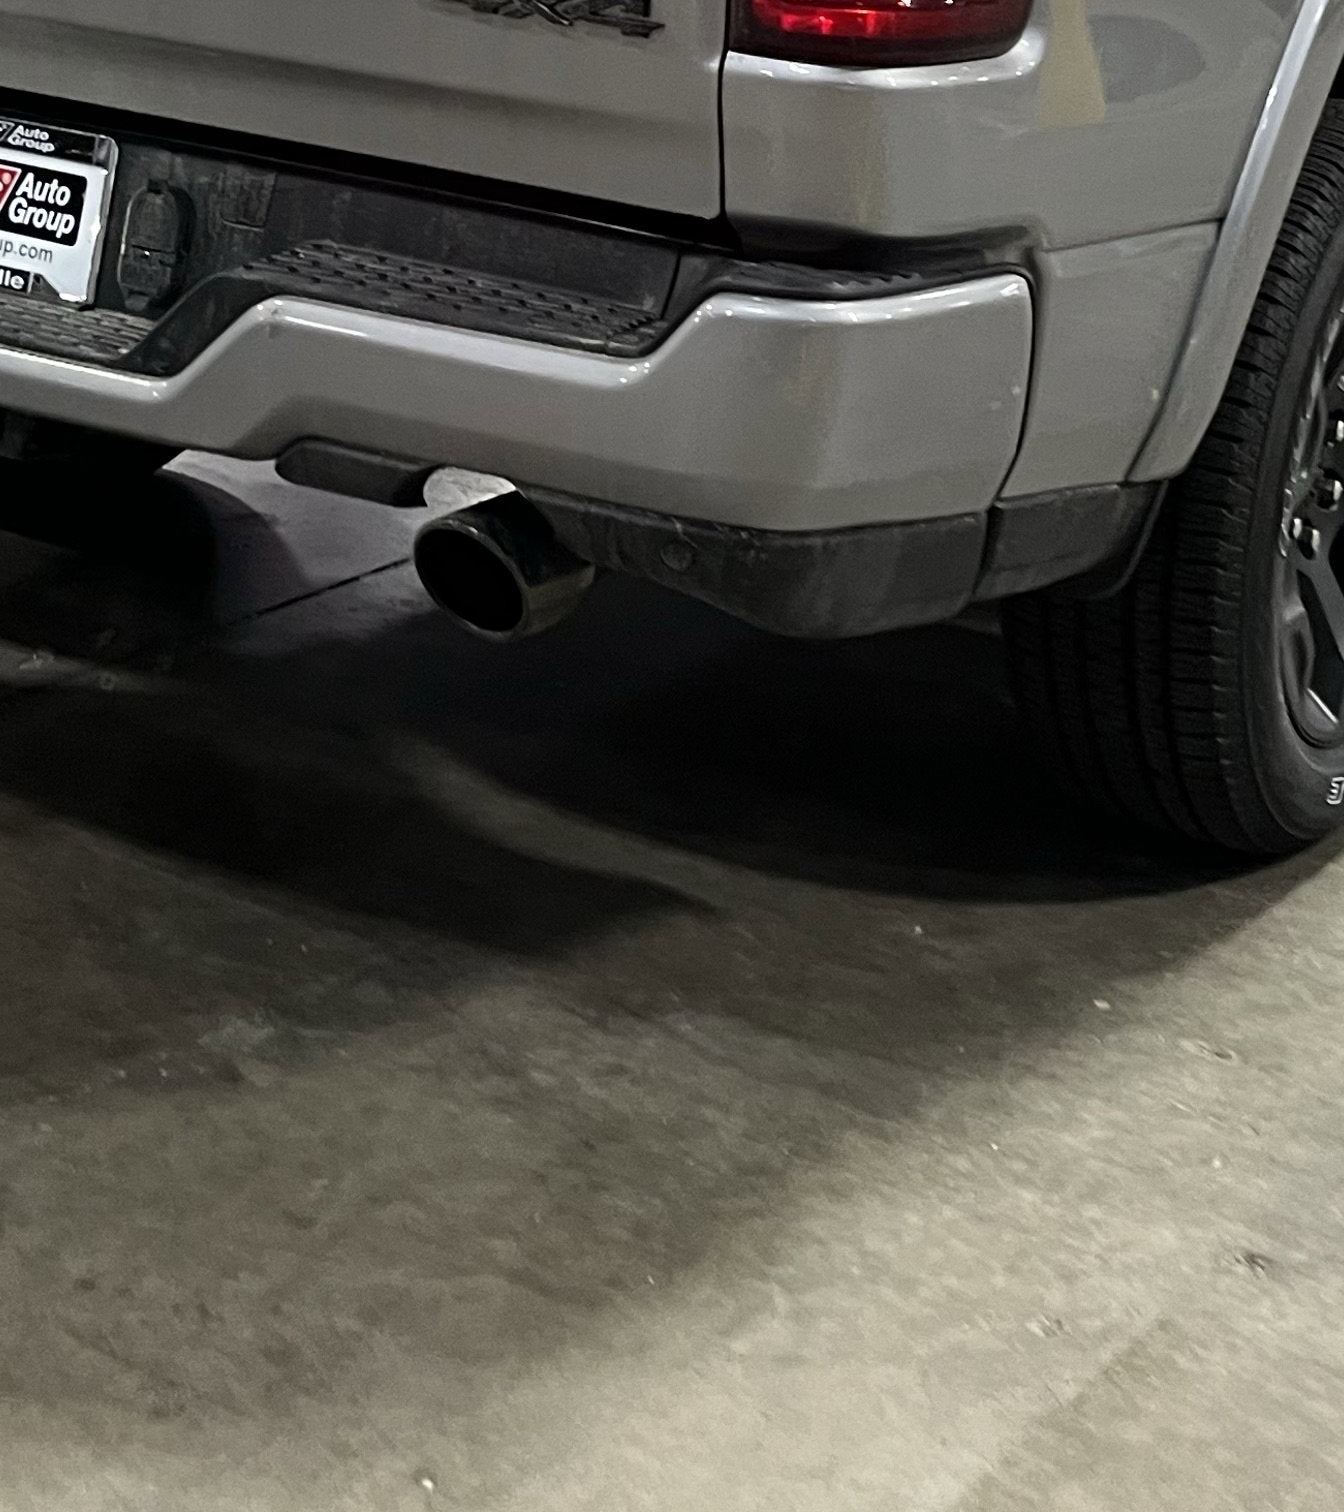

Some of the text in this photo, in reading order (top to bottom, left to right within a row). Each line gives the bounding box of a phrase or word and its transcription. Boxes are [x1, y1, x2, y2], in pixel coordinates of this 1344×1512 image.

[7, 133, 55, 153] Group
[14, 124, 50, 141] Auto
[16, 172, 71, 207] Auto
[8, 197, 76, 239] Group
